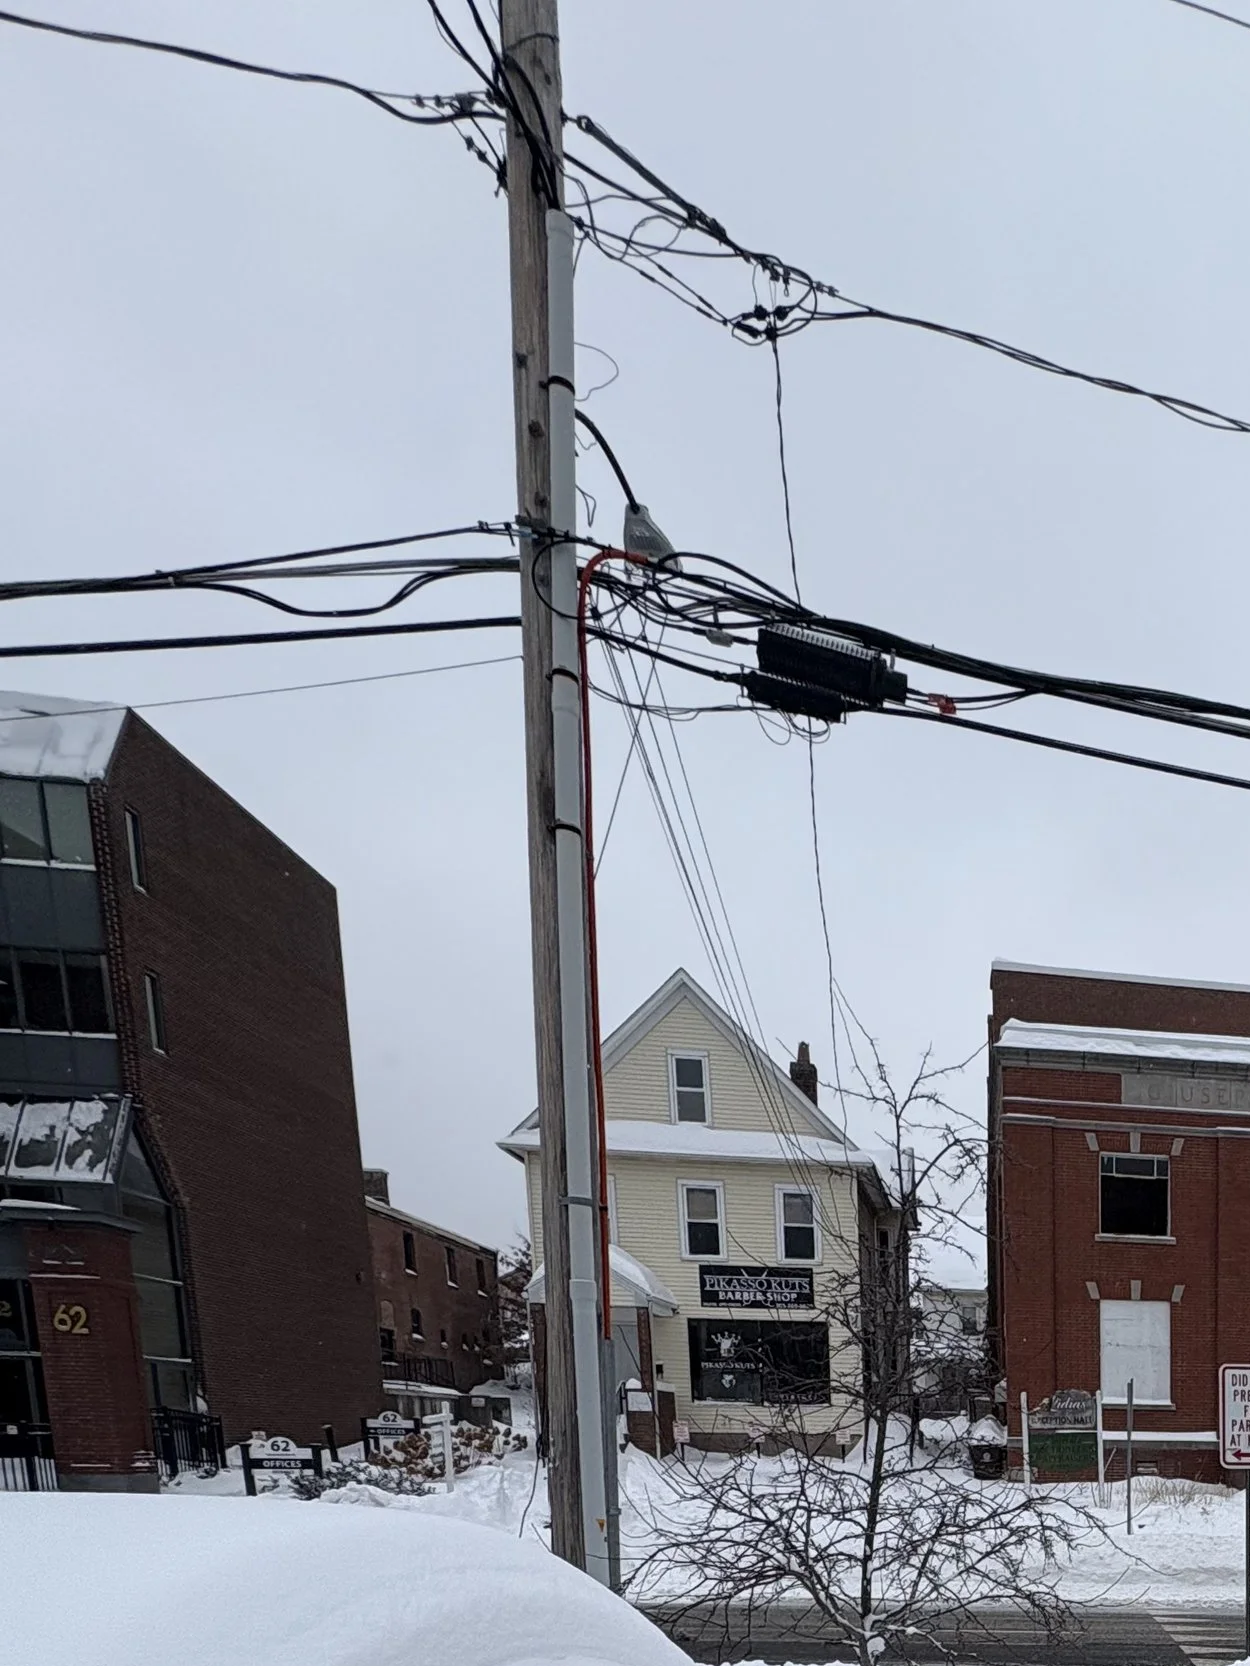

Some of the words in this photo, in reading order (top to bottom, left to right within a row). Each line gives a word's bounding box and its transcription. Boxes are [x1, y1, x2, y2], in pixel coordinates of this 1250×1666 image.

[704, 1276, 768, 1291] PIKASSO
[771, 1279, 811, 1293] KUTS
[719, 1291, 766, 1301] BARBER
[767, 1292, 798, 1302] SHOP
[53, 1304, 90, 1334] 62
[1231, 1374, 1248, 1387] DID
[382, 1413, 398, 1423] 62
[376, 1428, 406, 1436] OFFICES
[270, 1440, 291, 1452] 62
[1230, 1434, 1241, 1447] AT
[262, 1459, 302, 1468] OFFICES
